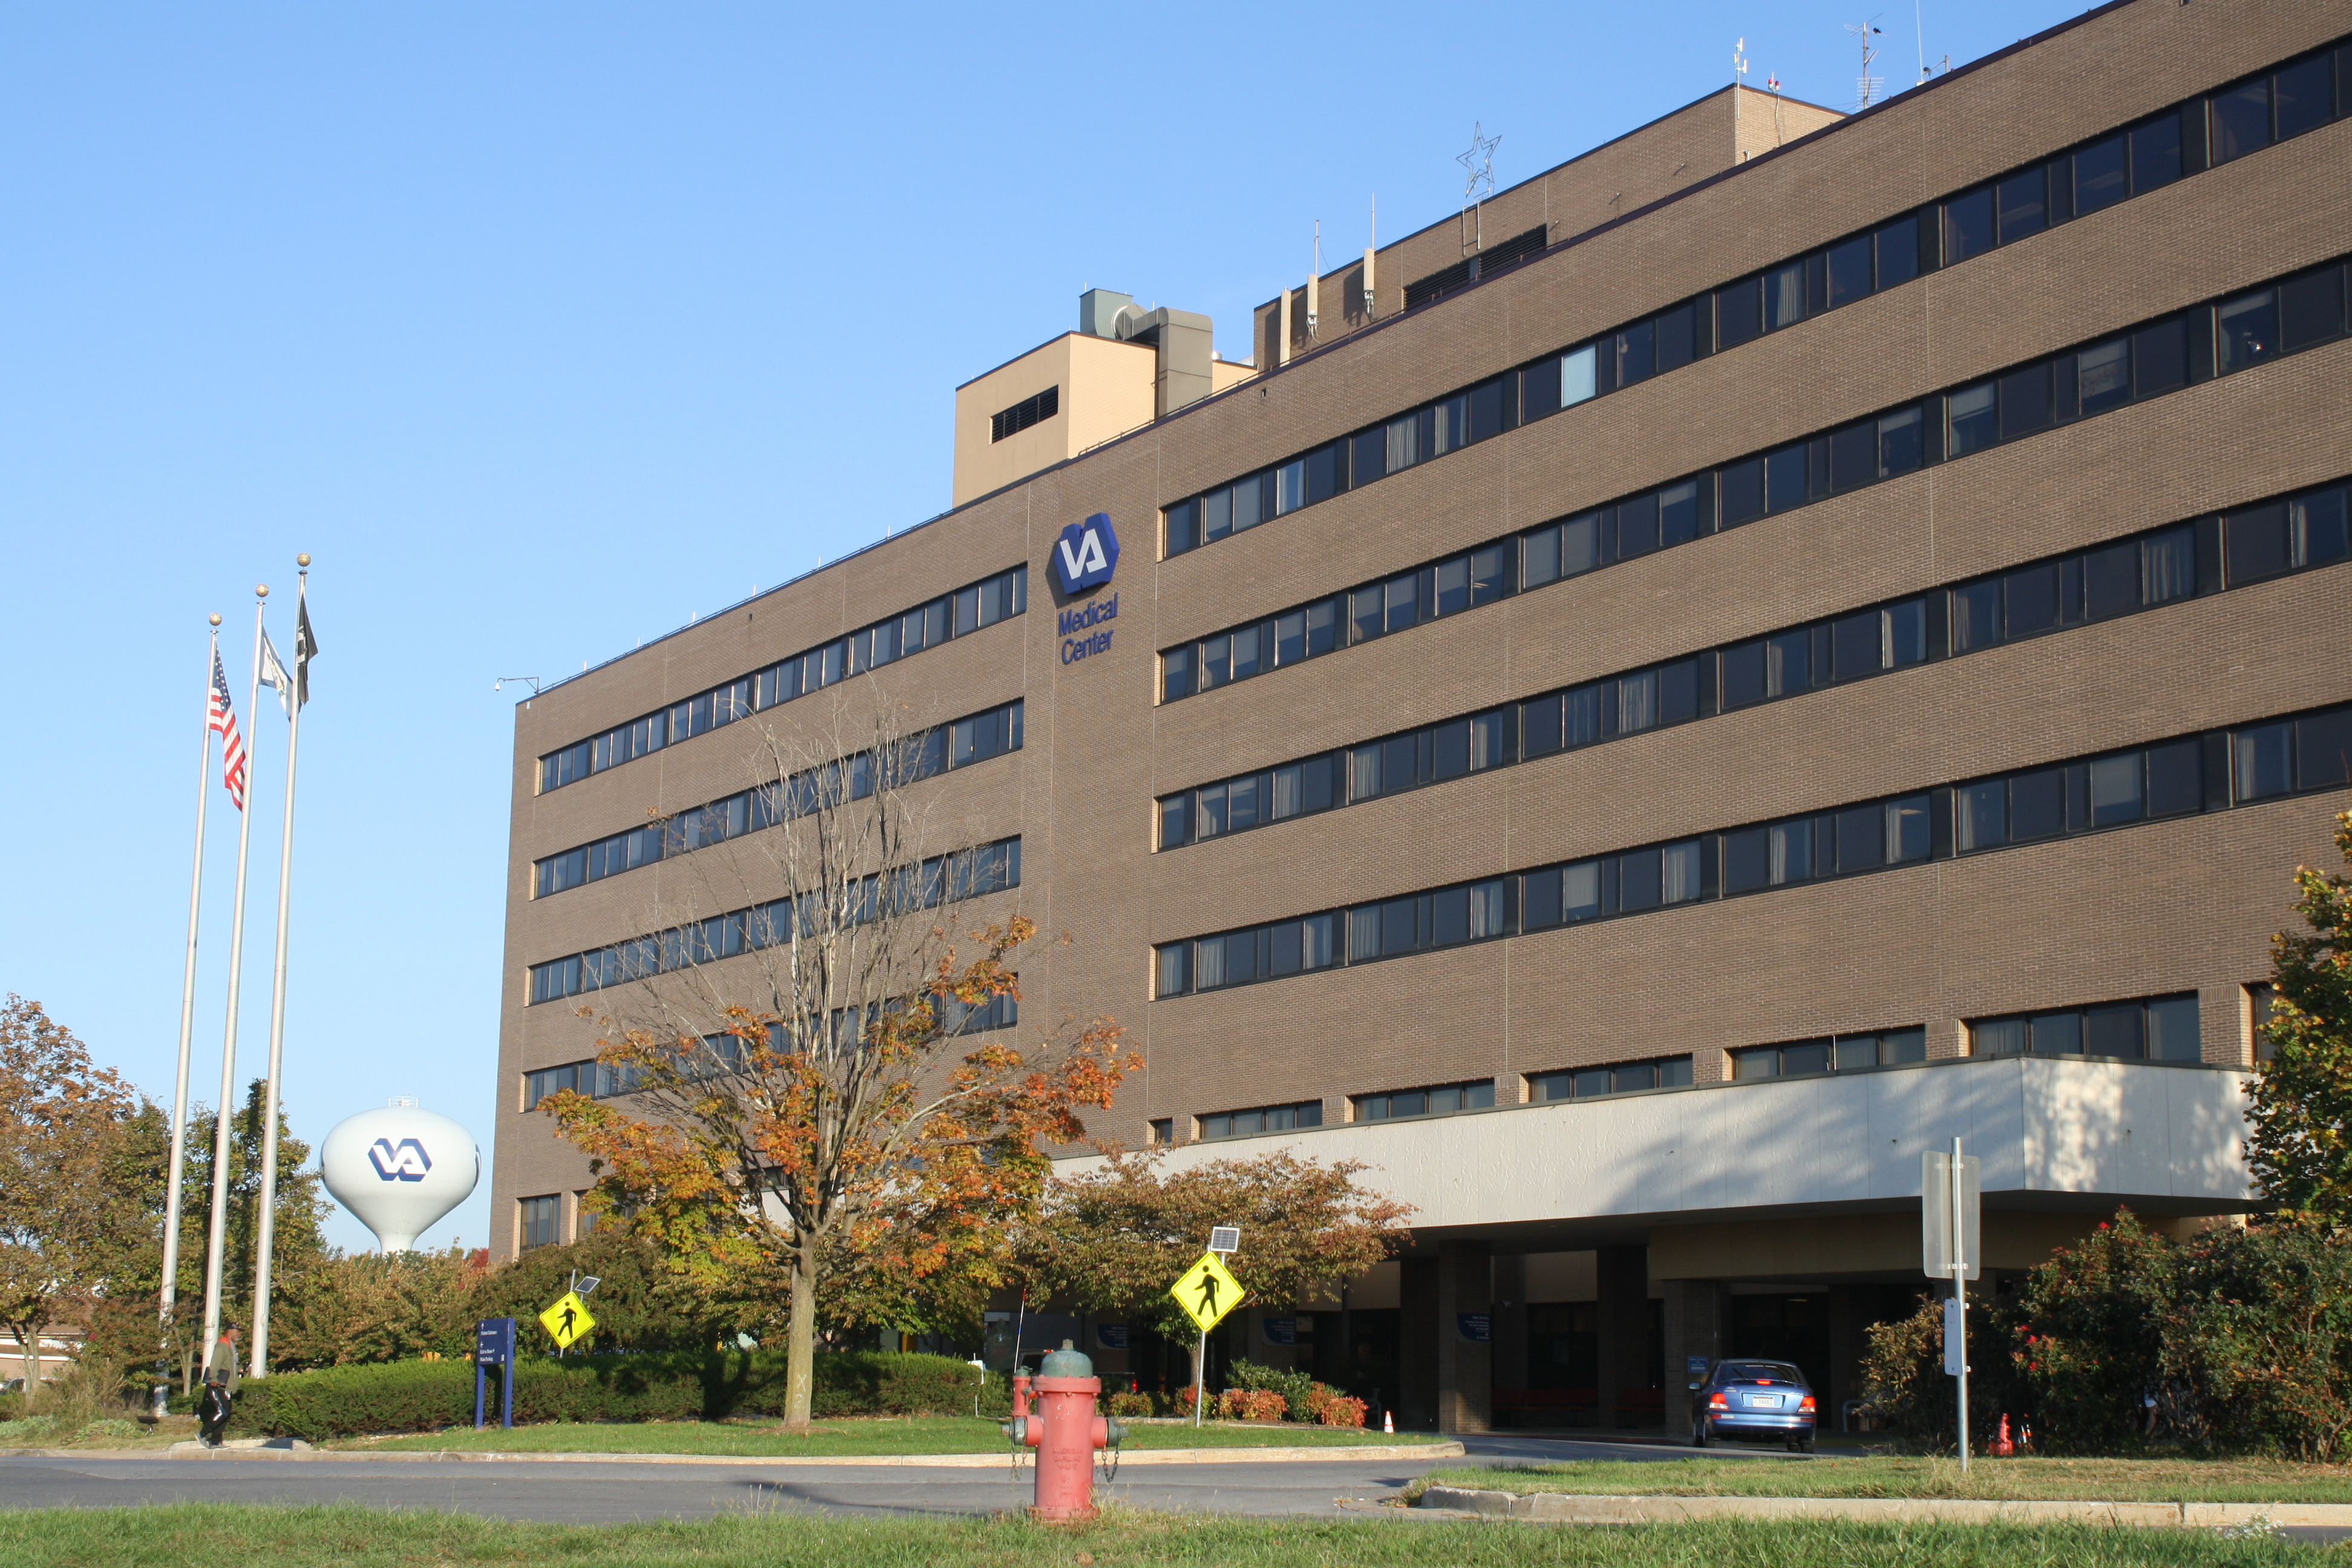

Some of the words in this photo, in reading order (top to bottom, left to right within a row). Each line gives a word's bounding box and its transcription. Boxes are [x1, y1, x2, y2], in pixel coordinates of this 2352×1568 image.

[1059, 528, 1108, 580] VA
[1058, 592, 1119, 637] Medical
[1062, 629, 1114, 665] Center
[372, 1144, 428, 1175] VA
